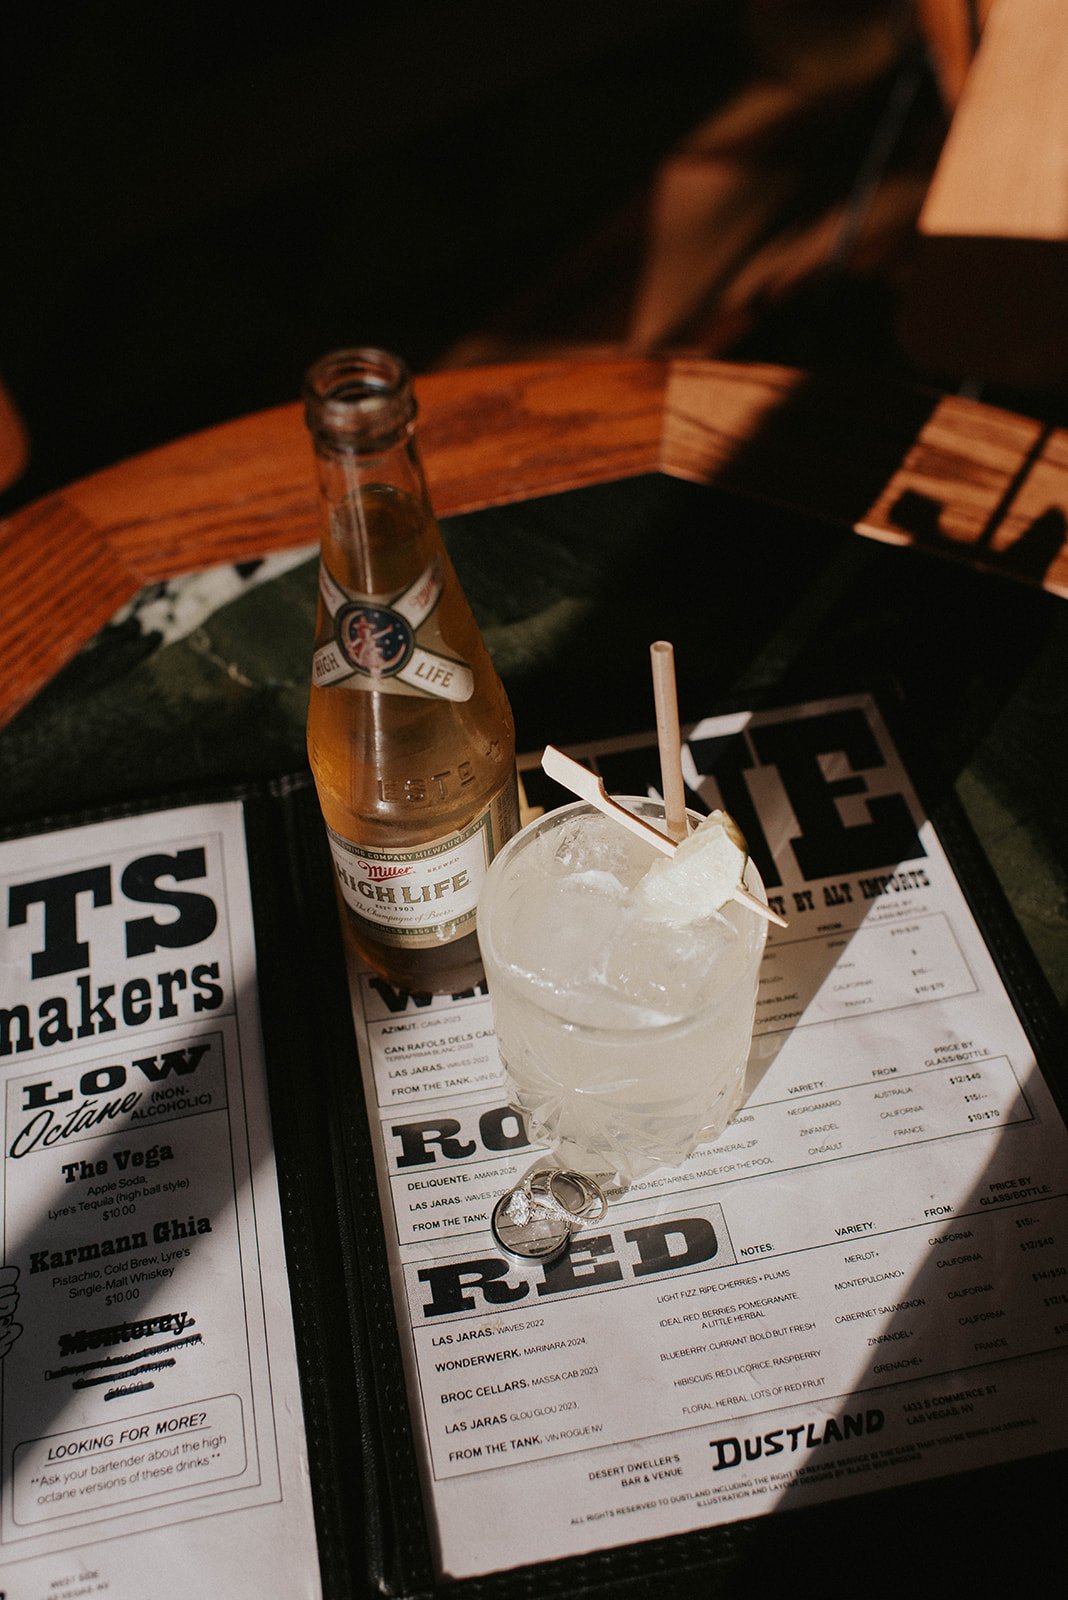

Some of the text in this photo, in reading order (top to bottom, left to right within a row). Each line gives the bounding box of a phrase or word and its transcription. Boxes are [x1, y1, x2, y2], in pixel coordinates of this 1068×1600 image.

[316, 653, 454, 688] HIGH LIFE
[336, 861, 470, 904] HIGH LIFE
[357, 860, 414, 880] Miller
[793, 890, 815, 913] BY
[859, 870, 931, 900] IMPORTS
[9, 847, 218, 980] TS
[384, 1045, 405, 1055] CAN
[961, 1041, 974, 1050] BY
[22, 1044, 211, 1111] LOW
[388, 1069, 408, 1079] LAS
[391, 1082, 442, 1097] FROM THE
[873, 1087, 913, 1100] AUSTRALIA
[131, 1093, 212, 1121] ALCOHOLIC)
[880, 1105, 924, 1120] CALIFORNIA
[10, 1087, 190, 1159] Octane (NON-
[893, 1125, 925, 1137] FRANCE
[391, 1106, 532, 1168] RO
[62, 1144, 174, 1184] The Vega
[474, 1170, 499, 1180] AMAYA
[719, 1164, 735, 1174] FOR
[737, 1161, 751, 1170] THE
[752, 1157, 774, 1167] POOL
[87, 1181, 117, 1197] Apple
[989, 1176, 1032, 1192] PRICE BY
[48, 1178, 190, 1220] Lyre's Tequila (high ball style)
[409, 1191, 491, 1212] LAS WAVES
[102, 1203, 136, 1222] $10.00
[412, 1216, 461, 1232] FROM THE
[30, 1216, 213, 1275] Karmann Ghia
[928, 1230, 974, 1246] CALIFORNIA
[104, 1261, 129, 1276] Cold
[161, 1248, 191, 1263] Lyre's
[417, 1217, 719, 1318] RED
[740, 1243, 775, 1257] NOTES:
[834, 1221, 877, 1237] VARIETY:
[936, 1253, 983, 1269] CALIFORNIA
[69, 1267, 175, 1299] Single-Malt Whiskey
[657, 1270, 791, 1304] LIGHT RIPE CHERRIES PLUMS
[105, 1288, 140, 1306] $10.00
[834, 1283, 995, 1324] CABERNET SAUVIGNON CALIFORNIA
[660, 1317, 682, 1328] IDEAL
[708, 1310, 766, 1328] LITTLE HERBAL
[750, 1331, 772, 1342] BOLD
[773, 1327, 788, 1338] BUT
[789, 1322, 817, 1334] FRESH
[432, 1334, 453, 1347] LAS
[496, 1322, 525, 1334] WAVES
[526, 1318, 545, 1329] 2022
[523, 1340, 567, 1356] MARINARA
[715, 1368, 733, 1379] RED
[773, 1350, 822, 1366] RASPBERRY
[440, 1390, 473, 1404] BROC
[532, 1374, 562, 1386] MASSA
[562, 1370, 579, 1381] CAB
[580, 1366, 599, 1377] 2023
[750, 1376, 826, 1400] LOTS RED FRUIT
[932, 1386, 985, 1407] COMMERCE
[445, 1405, 558, 1434] LAS JARAS GLOU GLOU
[906, 1413, 926, 1425] LAS
[962, 1403, 975, 1414] NV
[47, 1412, 207, 1461] LOOKING FOR MORE?
[449, 1448, 482, 1462] FROM
[484, 1442, 507, 1454] THE
[545, 1433, 559, 1443] VIN
[560, 1427, 591, 1439] ROGUE
[591, 1423, 604, 1434] NV
[63, 1434, 227, 1485] your bartender about the high
[588, 1453, 681, 1481] DESERT DWELLER'S
[37, 1463, 174, 1505] octane versions of these
[621, 1467, 683, 1488] BAR VENUE
[570, 1516, 585, 1525] ALL
[586, 1511, 615, 1522] RIGHTS
[616, 1503, 657, 1516] RESERVED
[671, 1489, 711, 1506] DUSTLAND
[712, 1480, 754, 1496] INCLUDING
[755, 1475, 769, 1485] THE
[770, 1471, 793, 1482] RIGHT
